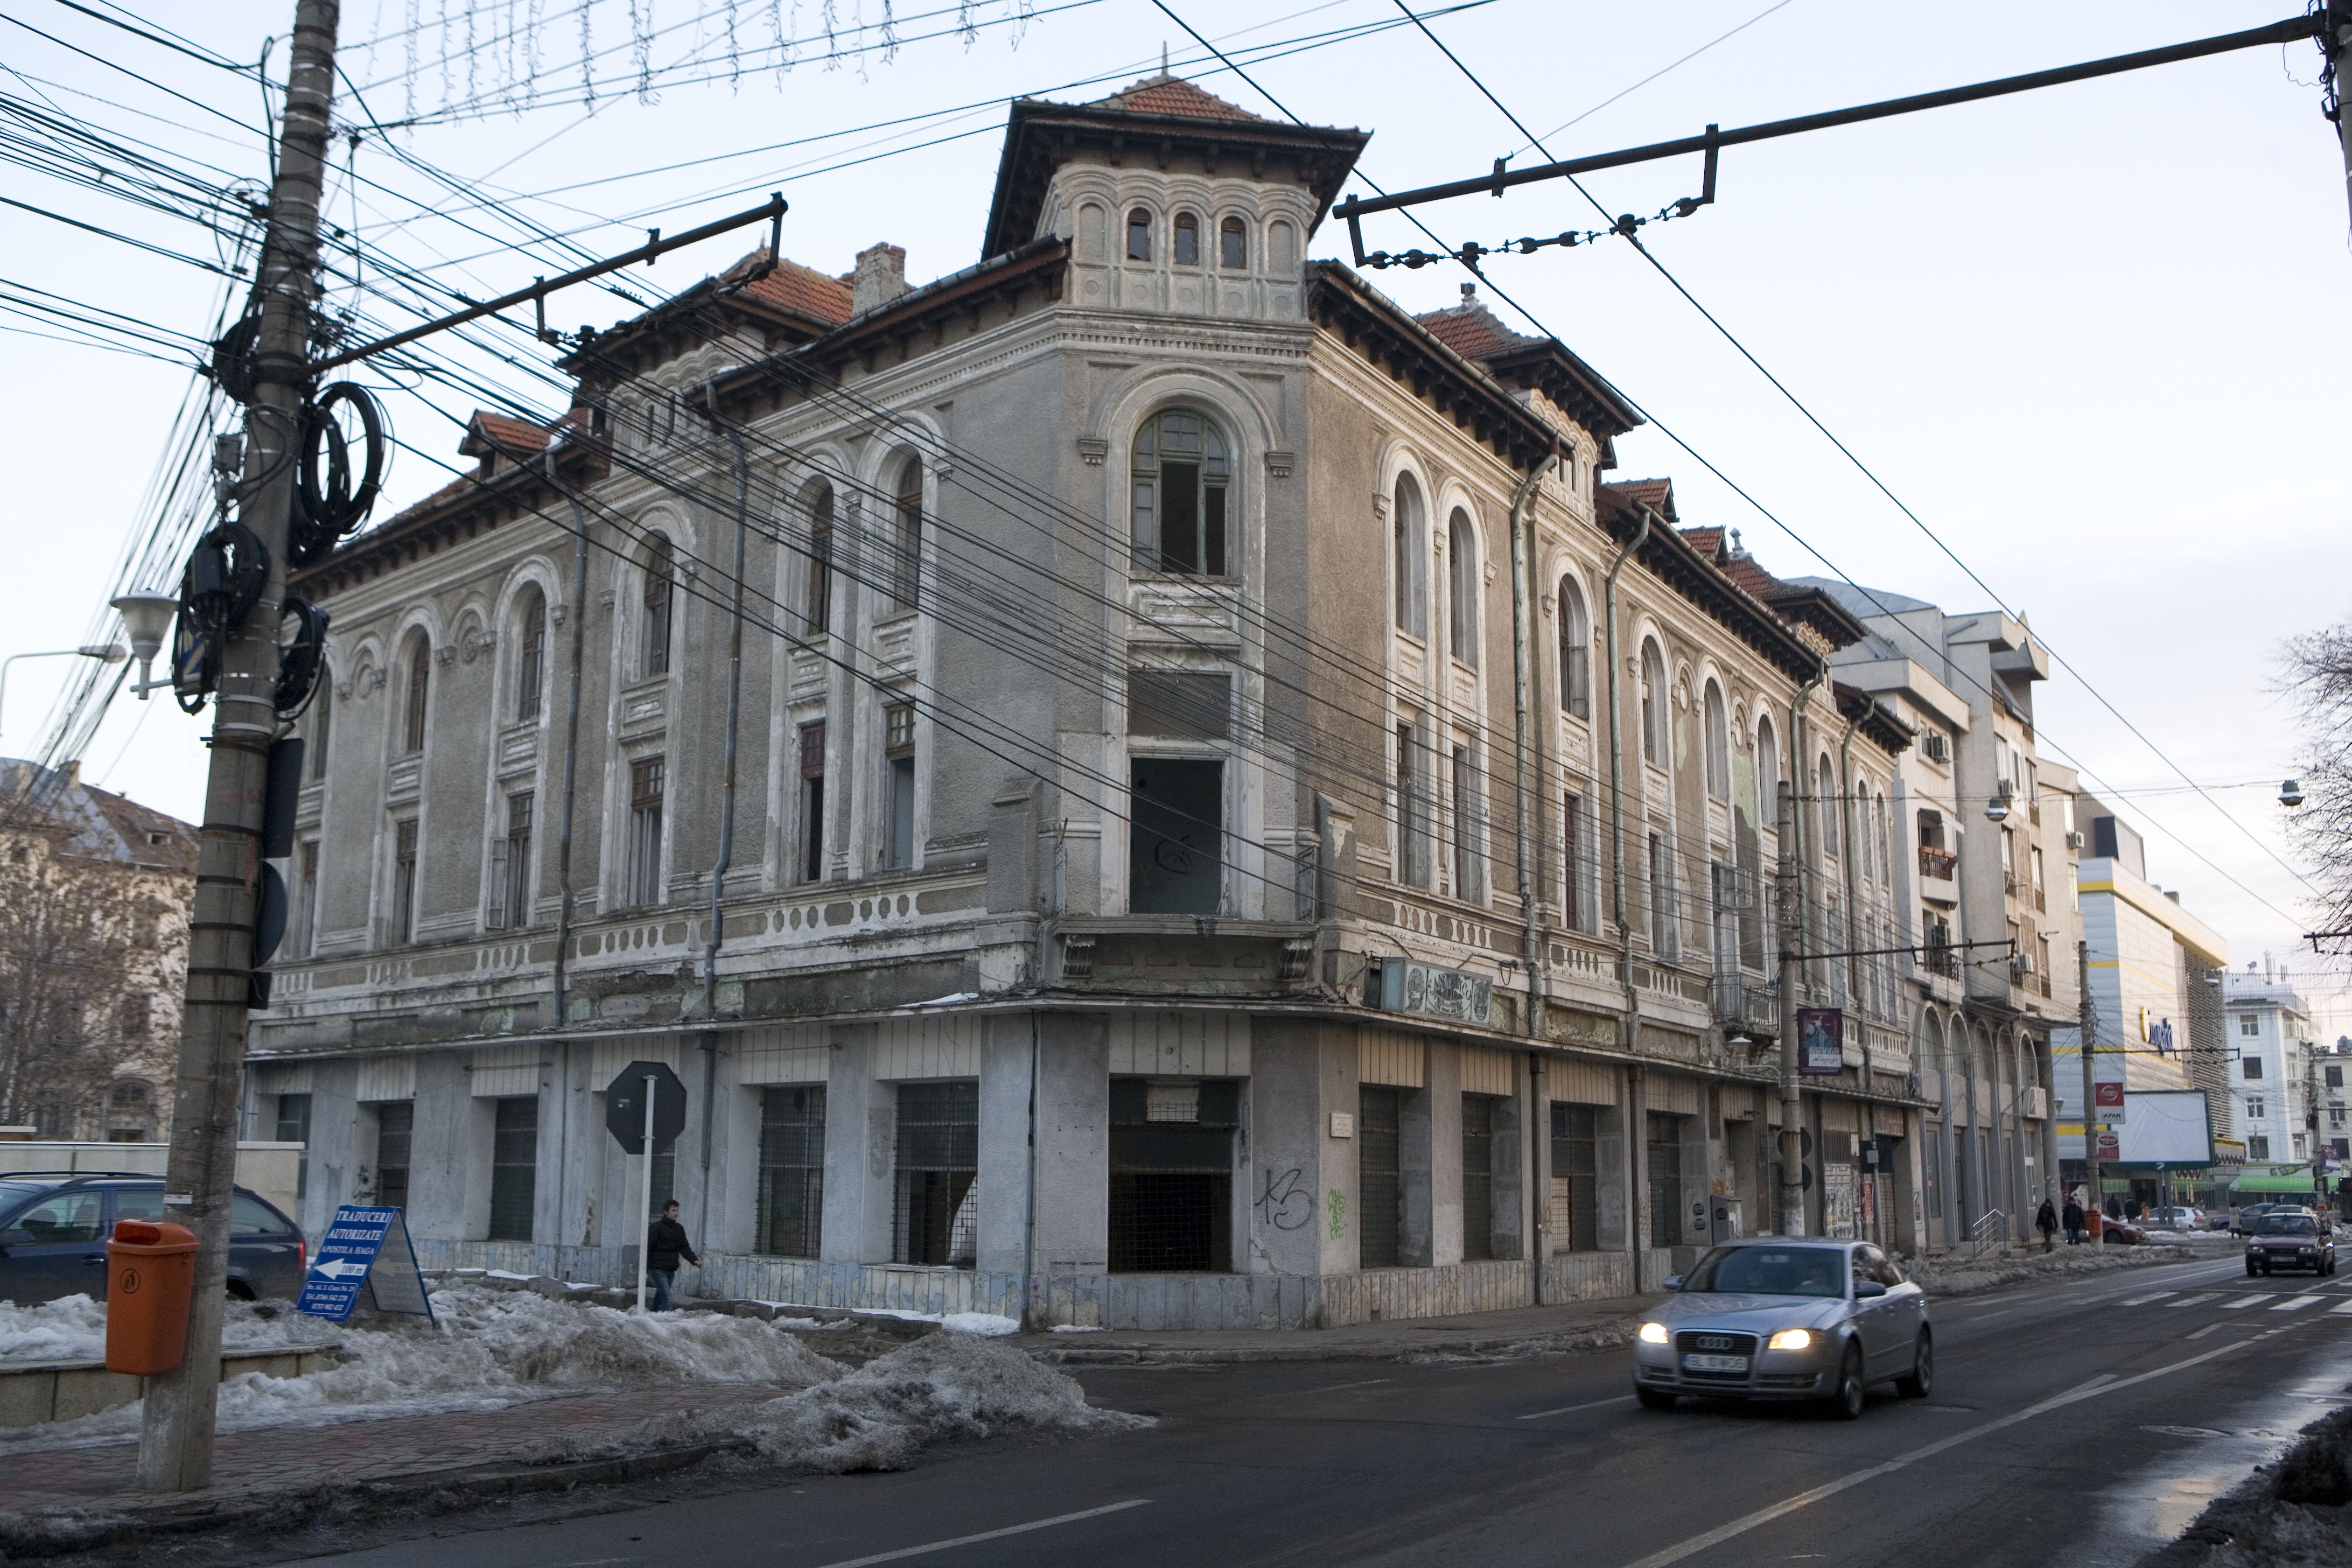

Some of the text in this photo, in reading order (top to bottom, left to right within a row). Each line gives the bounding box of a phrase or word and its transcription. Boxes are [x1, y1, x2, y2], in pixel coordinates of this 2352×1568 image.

[336, 1210, 392, 1223] TRADUCERI
[327, 1228, 383, 1241] AUTORIZATE
[320, 1245, 375, 1255] APOSTILA HAGA
[341, 1265, 355, 1273] 100
